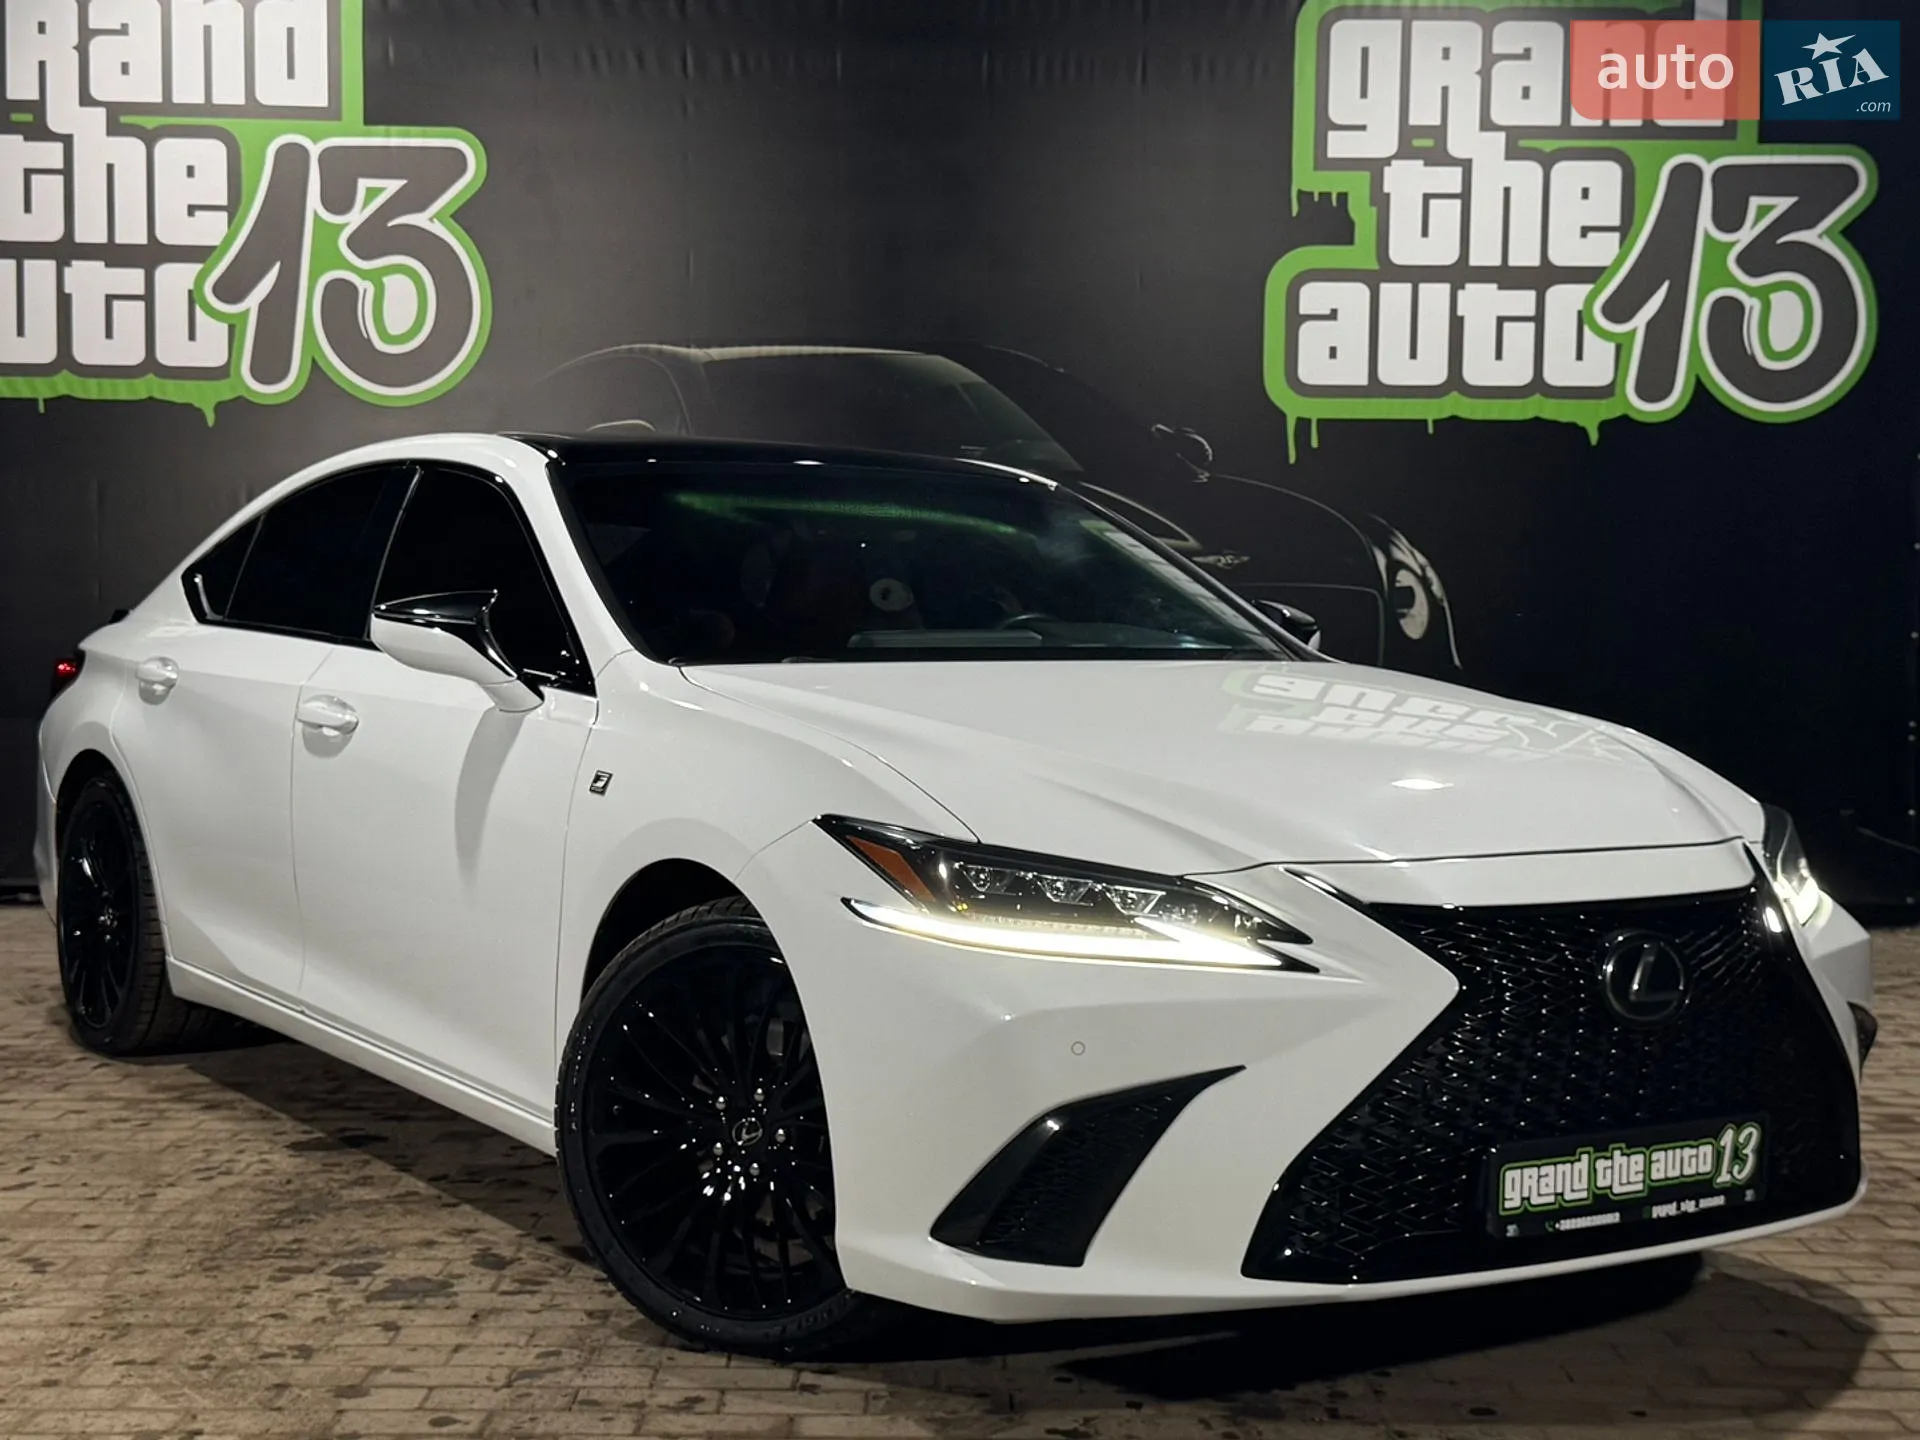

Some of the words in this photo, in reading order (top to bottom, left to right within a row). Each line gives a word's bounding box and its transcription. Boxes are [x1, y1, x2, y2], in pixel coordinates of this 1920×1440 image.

[205, 134, 480, 394] 13
[1383, 131, 1623, 267] the
[1297, 281, 1616, 387] auto
[1592, 153, 1867, 411] 13
[1594, 1149, 1645, 1195] the
[1650, 1143, 1714, 1181] auto
[1716, 1125, 1760, 1184] 13
